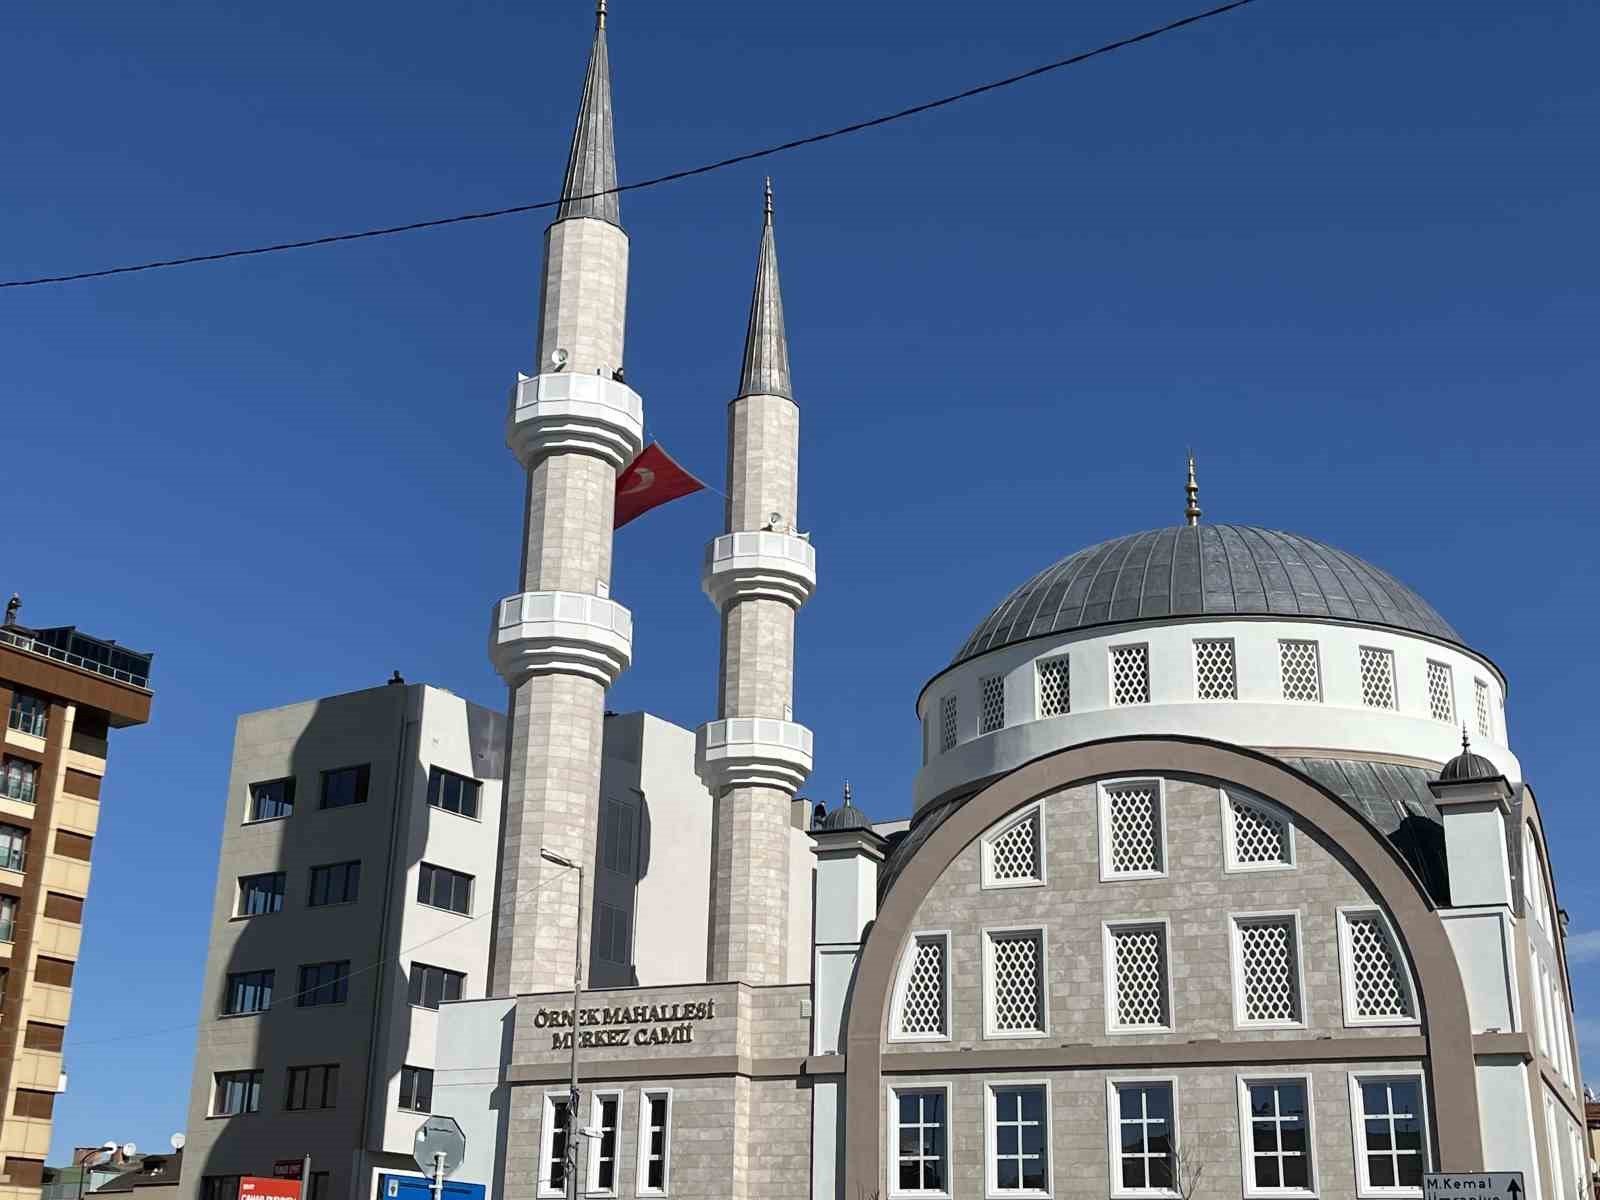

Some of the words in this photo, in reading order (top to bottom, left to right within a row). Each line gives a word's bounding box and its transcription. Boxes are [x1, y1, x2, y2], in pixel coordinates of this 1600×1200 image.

[534, 1008, 600, 1028] ÖRNEK
[602, 998, 714, 1025] MAHALLESİ
[634, 1022, 693, 1046] CAMİİ
